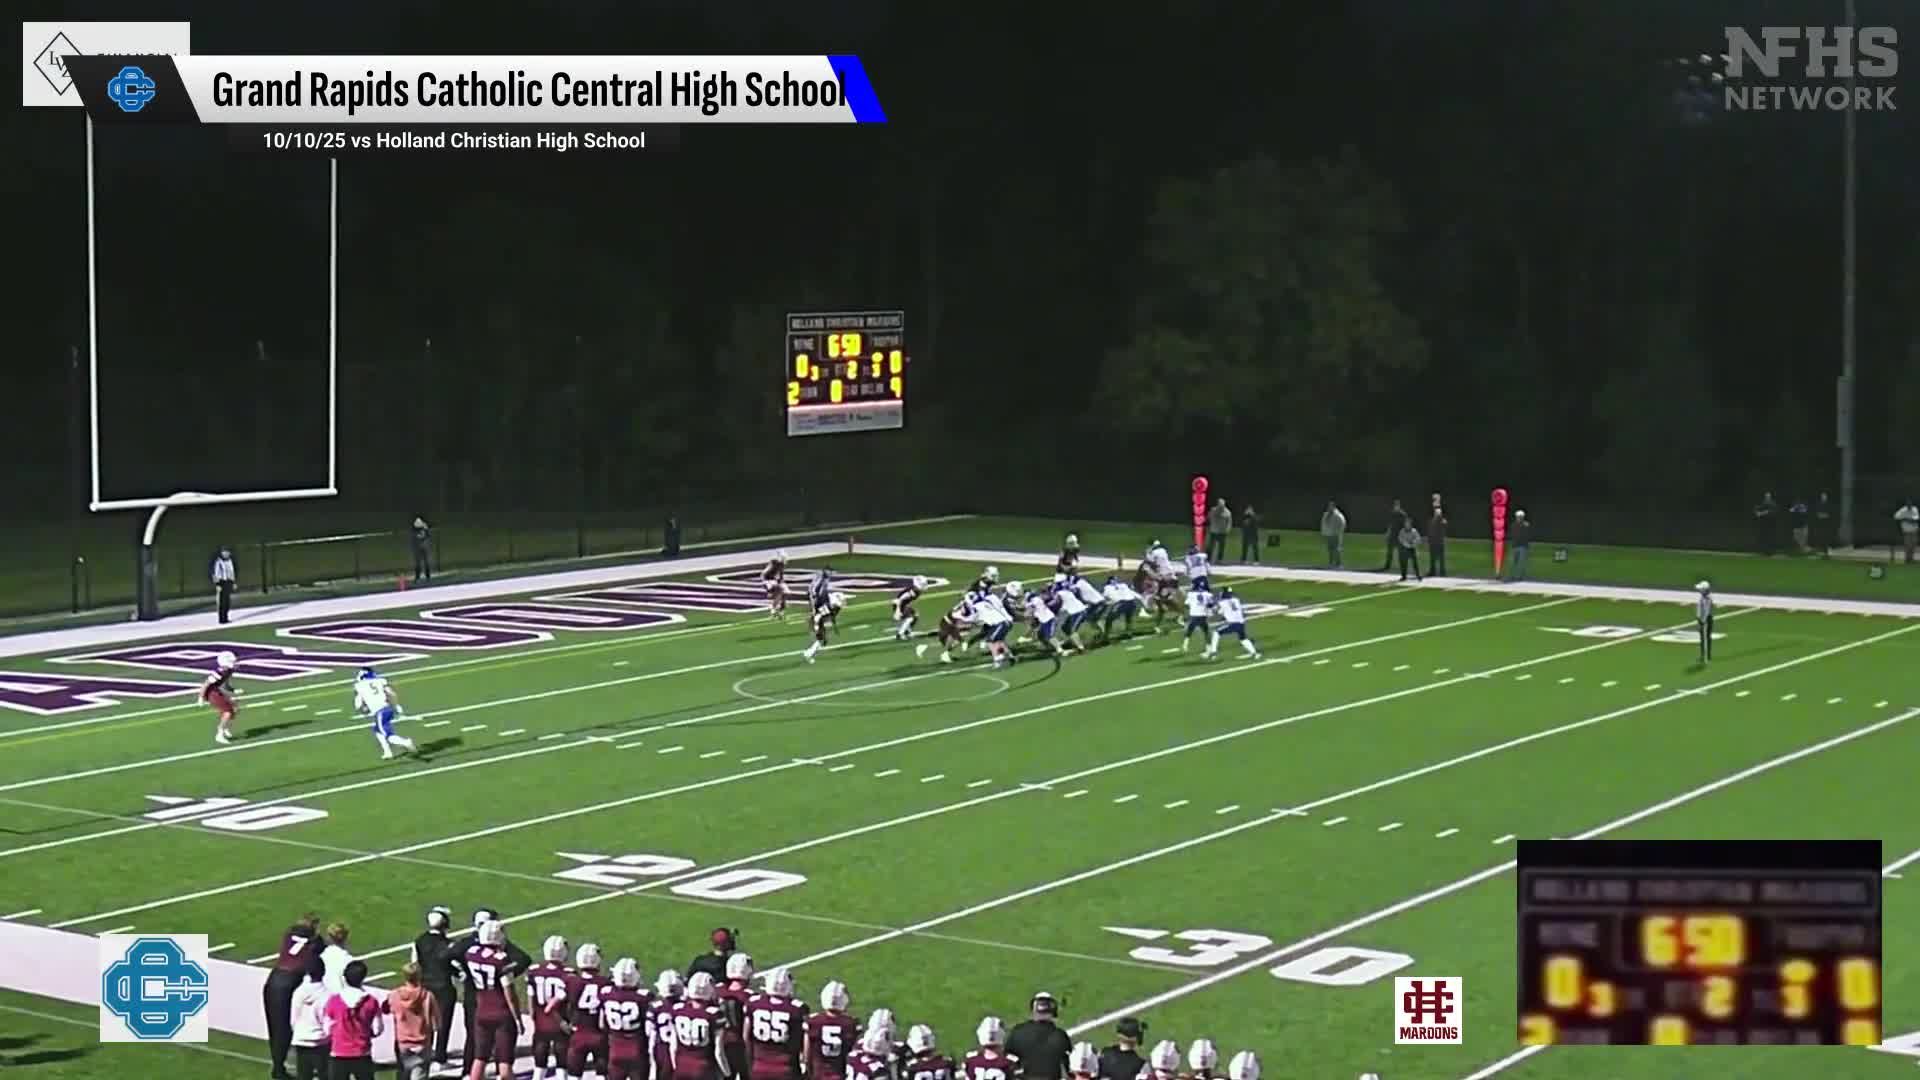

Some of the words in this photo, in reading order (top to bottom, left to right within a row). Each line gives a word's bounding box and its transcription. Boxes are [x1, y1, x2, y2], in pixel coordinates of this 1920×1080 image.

[553, 853, 807, 901] 20
[289, 935, 308, 955] 7
[1128, 929, 1415, 985] 30
[467, 961, 496, 990] 57
[579, 984, 600, 1010] 4
[604, 1001, 640, 1031] 62
[675, 1016, 709, 1046] 80
[752, 1009, 790, 1042] 65
[821, 1025, 842, 1056] 5
